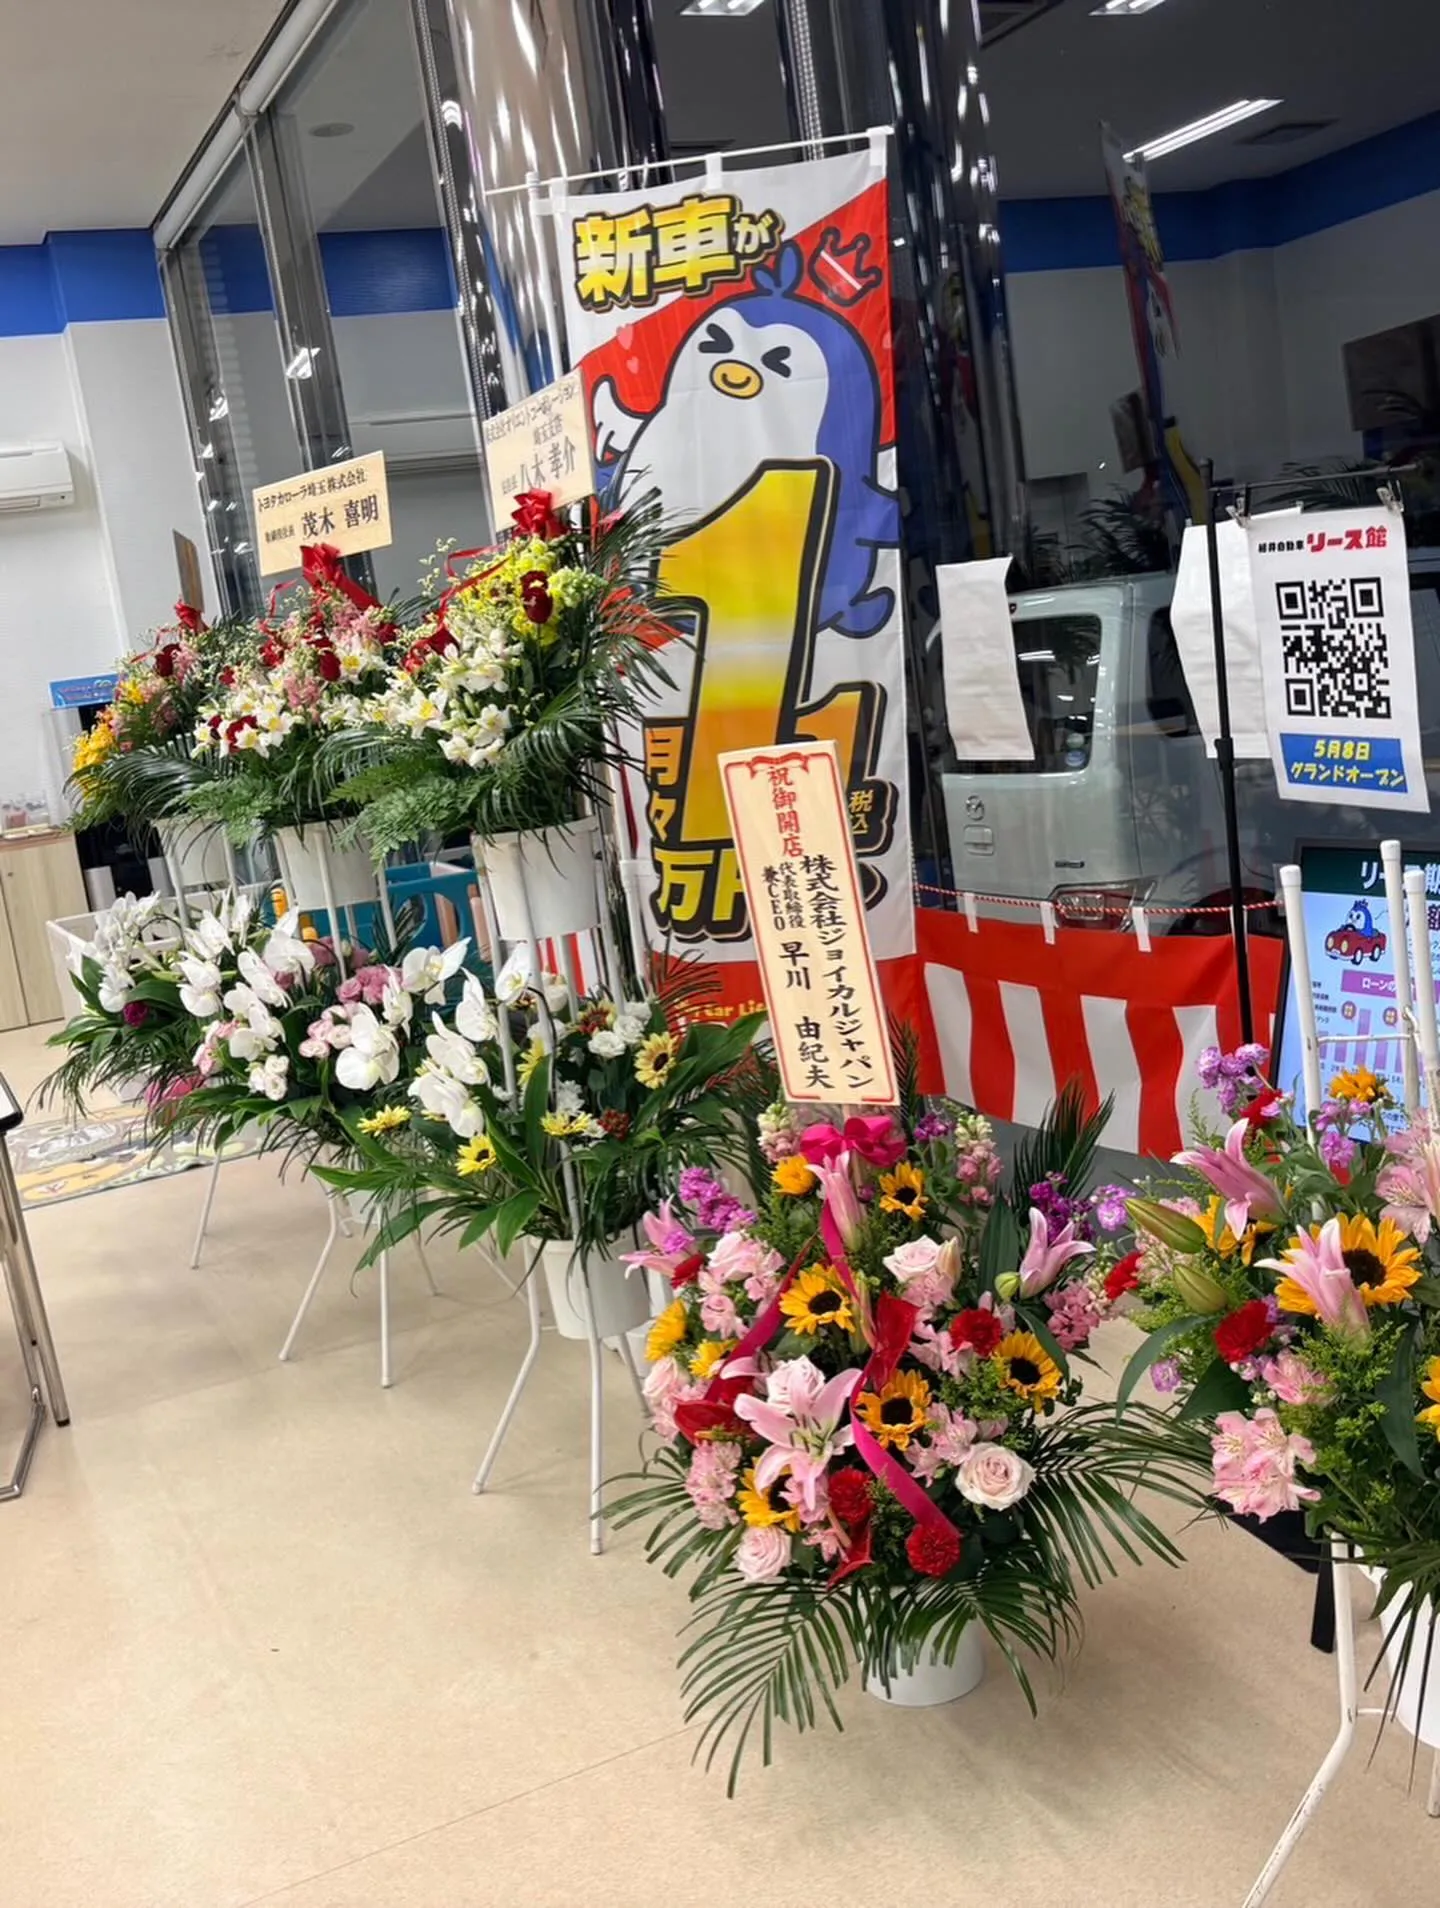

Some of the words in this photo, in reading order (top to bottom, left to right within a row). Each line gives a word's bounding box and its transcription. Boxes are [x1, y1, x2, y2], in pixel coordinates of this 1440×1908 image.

[573, 194, 784, 310] 新車が
[258, 468, 367, 512] トヨタカローラ埼玉株式会社
[302, 507, 335, 539] 茂木
[344, 494, 379, 528] 喜明
[1306, 525, 1387, 553] リース館
[1291, 762, 1404, 787] グランドオープン
[1314, 739, 1370, 761] 5月8日
[767, 766, 804, 858] 祝御開店
[779, 862, 806, 928] 代表取締役
[779, 941, 812, 990] 早川
[799, 854, 875, 1090] 株式会社ジョイカルジャパン
[795, 1016, 836, 1090] 由紀夫
